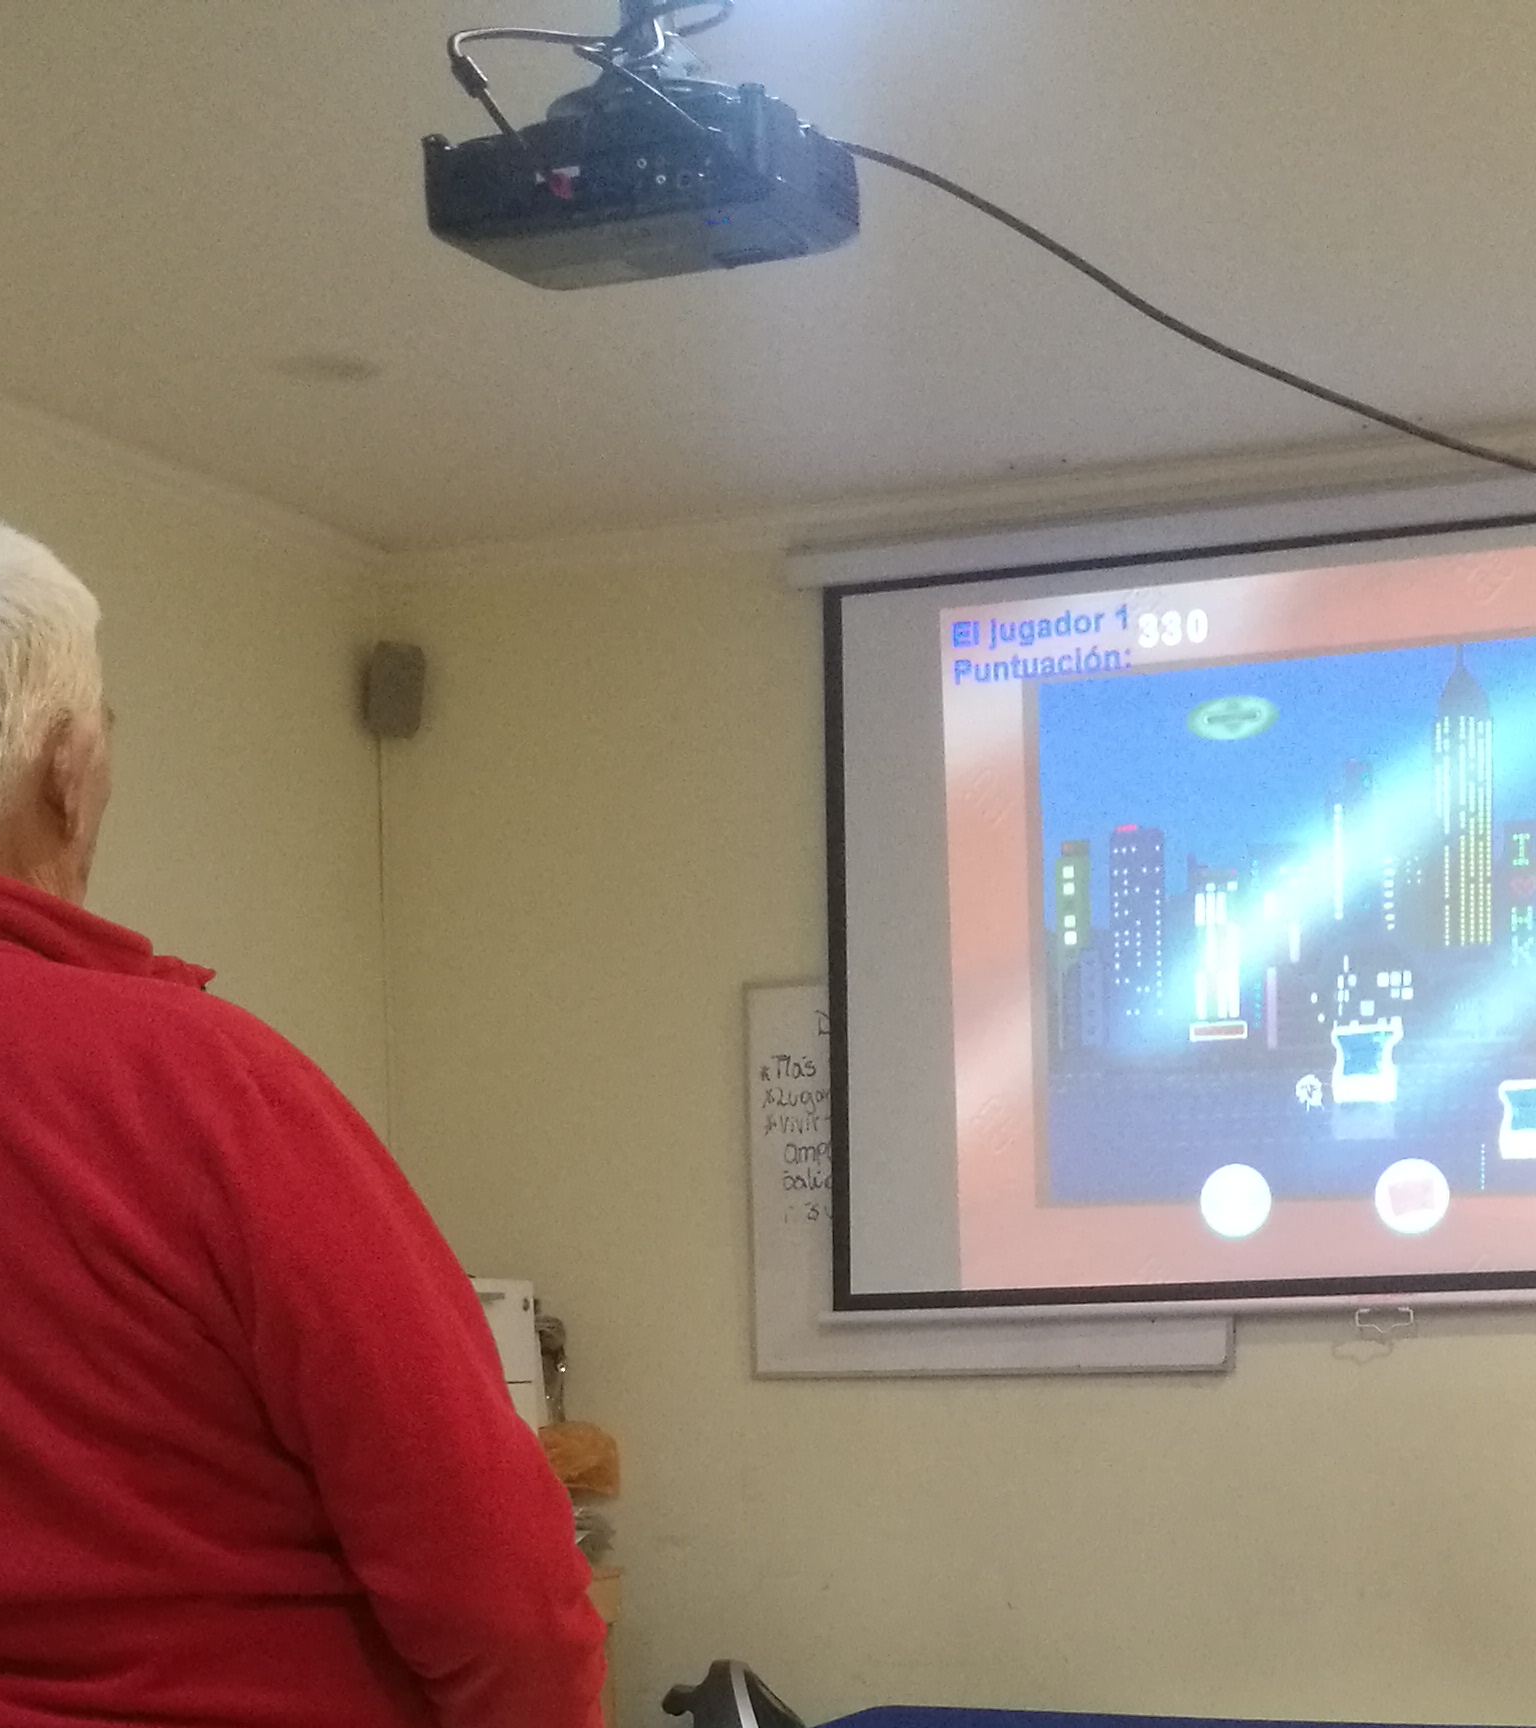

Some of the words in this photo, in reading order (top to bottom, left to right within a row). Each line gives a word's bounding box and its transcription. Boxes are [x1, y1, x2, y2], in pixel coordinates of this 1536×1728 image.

[951, 620, 980, 648] El
[1115, 603, 1129, 631] 1
[1137, 608, 1209, 648] 330
[953, 646, 1132, 685] Puntuación:
